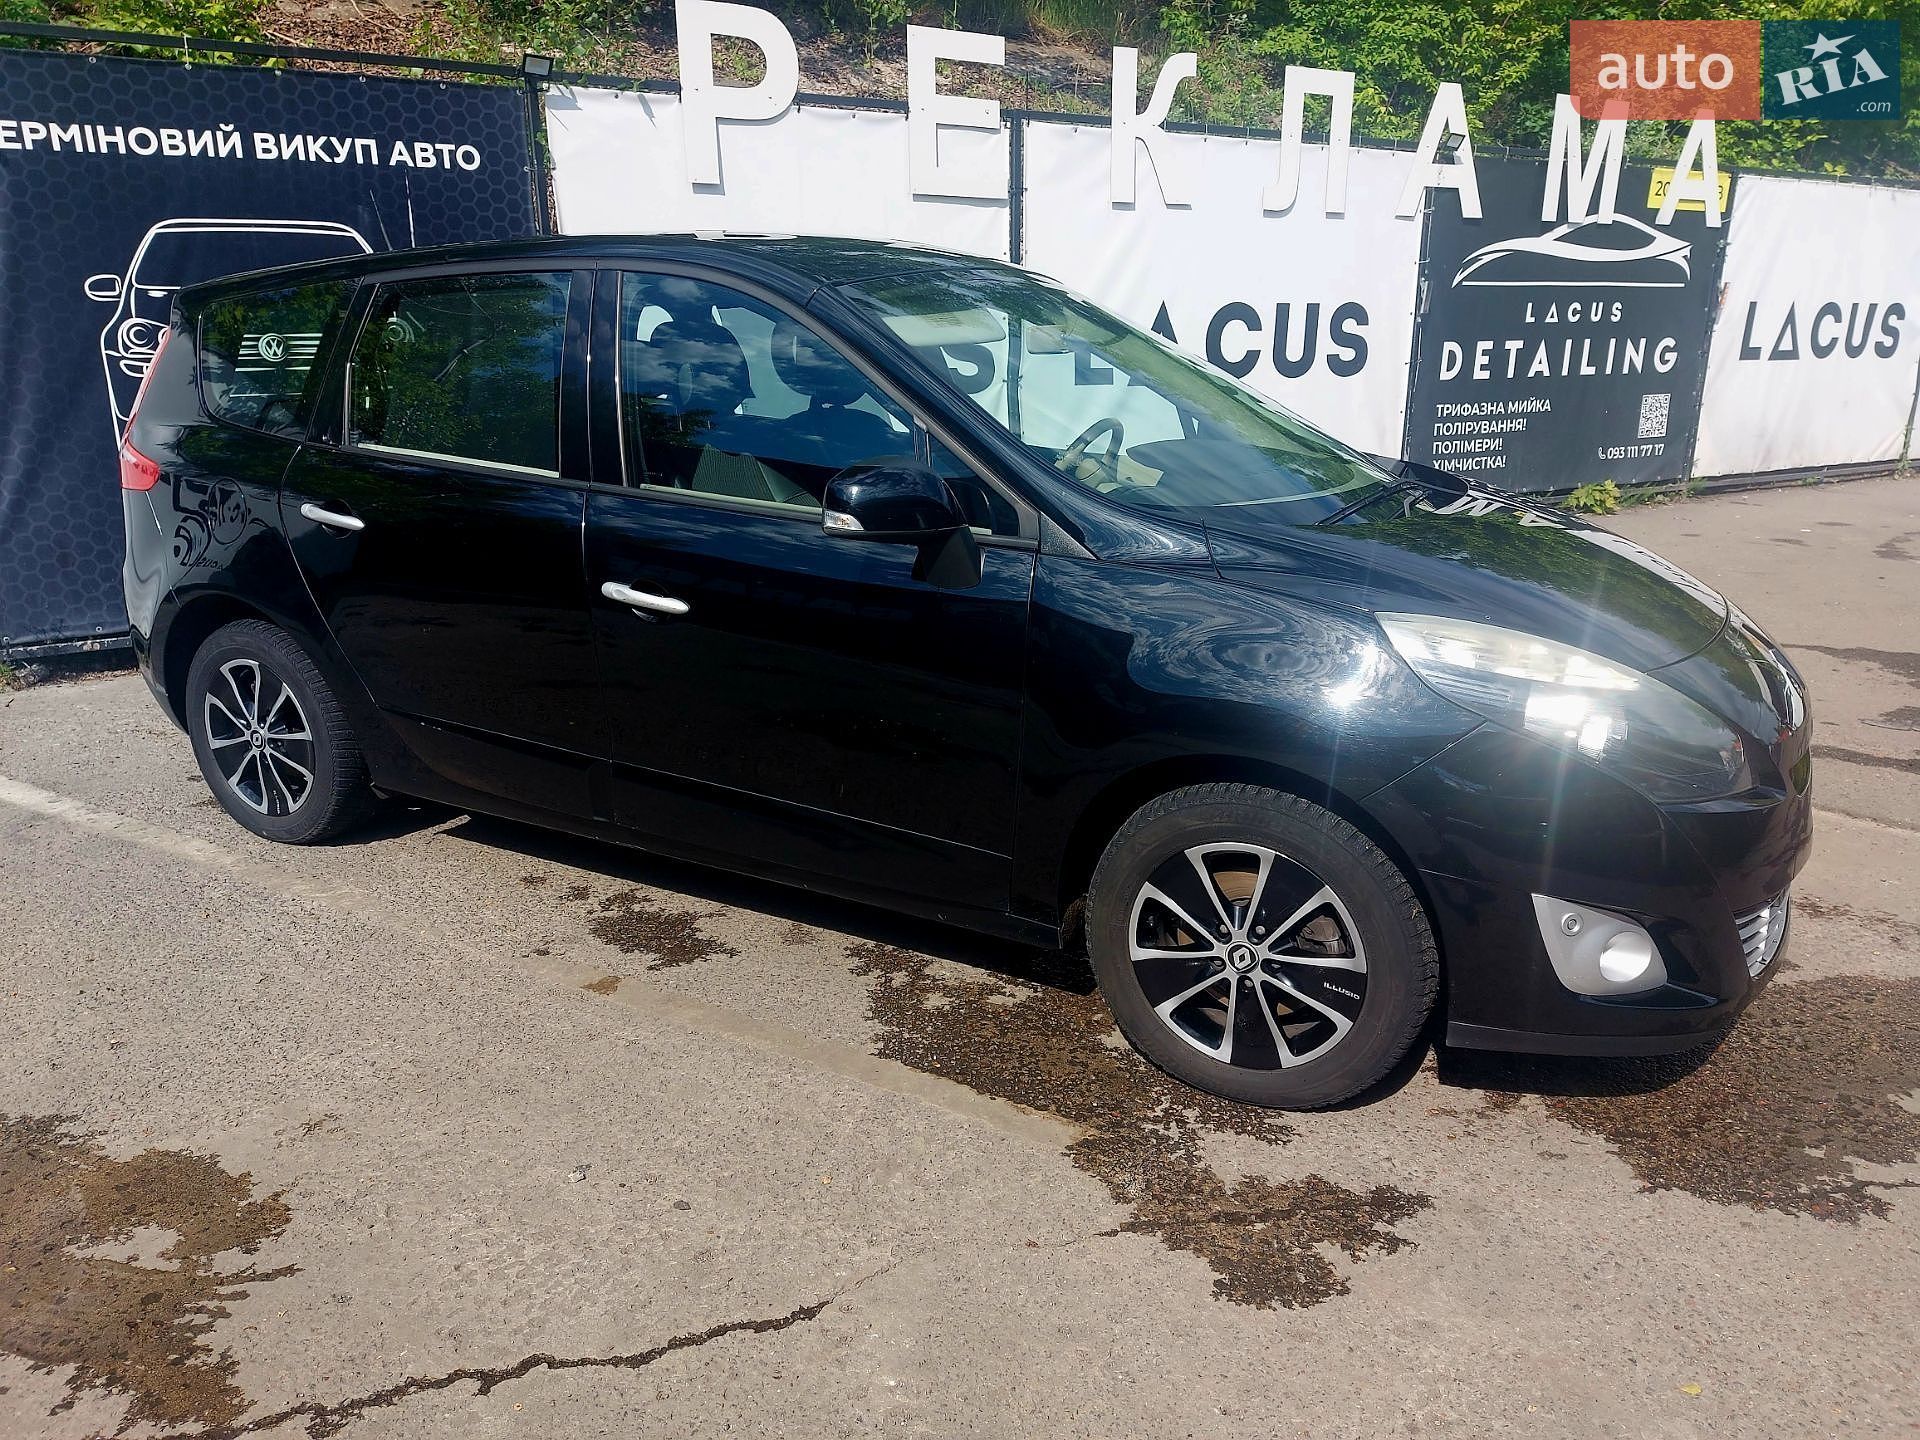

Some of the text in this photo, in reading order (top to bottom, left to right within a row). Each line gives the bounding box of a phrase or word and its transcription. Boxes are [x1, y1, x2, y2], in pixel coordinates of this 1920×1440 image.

[675, 0, 1721, 227] РЕКЛАМА
[0, 119, 481, 171] ЕРМІНОВИЙ ВИКУП АВТО
[1525, 301, 1623, 323] LACUS
[1739, 301, 1906, 361] LACUS
[1440, 337, 1678, 381] DETAILING
[1436, 396, 1551, 417] ТРИФАЗНА МИЙКА
[1433, 418, 1527, 436] ПОЛІРУВАННЯ!
[1432, 438, 1503, 454] ПОЛІМЕРИ!
[1607, 443, 1665, 459] 093 111 77 17
[1432, 455, 1507, 471] ХІМЧИСТКА!
